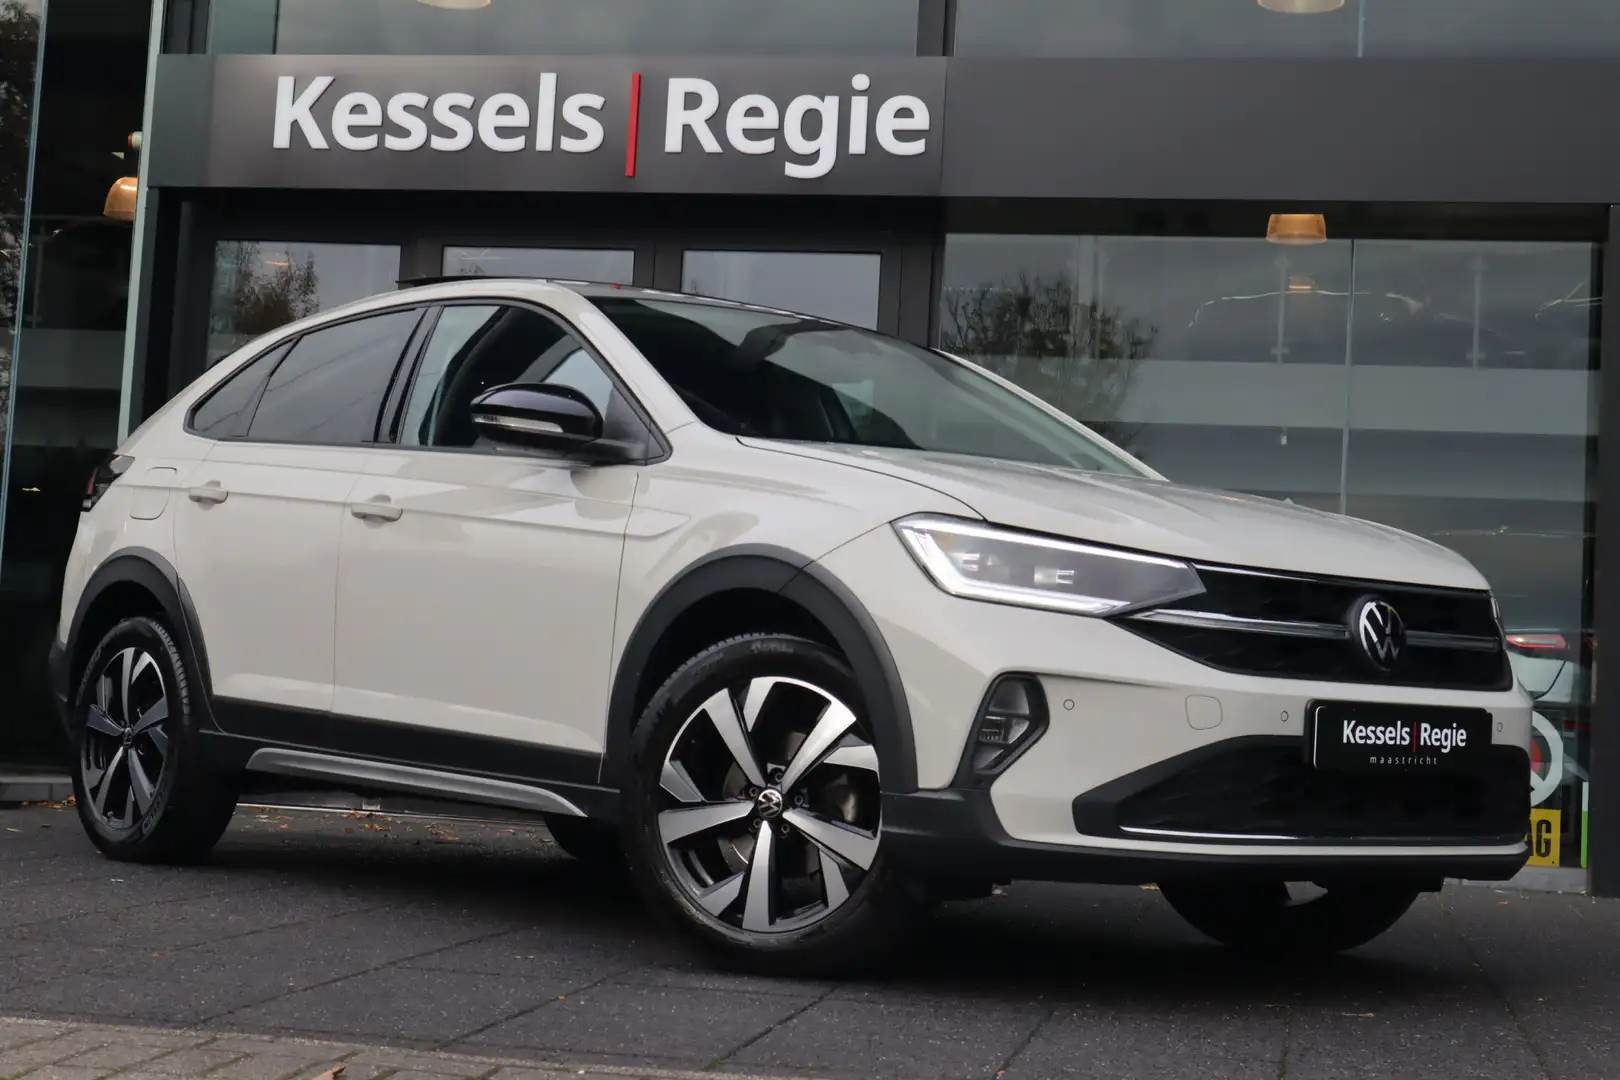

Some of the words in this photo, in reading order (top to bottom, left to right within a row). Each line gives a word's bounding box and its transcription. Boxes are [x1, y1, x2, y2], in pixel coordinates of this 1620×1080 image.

[272, 72, 606, 153] Kessels
[664, 73, 930, 179] Regie
[1342, 720, 1411, 745] Kessels
[1420, 722, 1467, 754] Regie
[1369, 756, 1437, 765] maastricht
[1530, 819, 1552, 858] G
